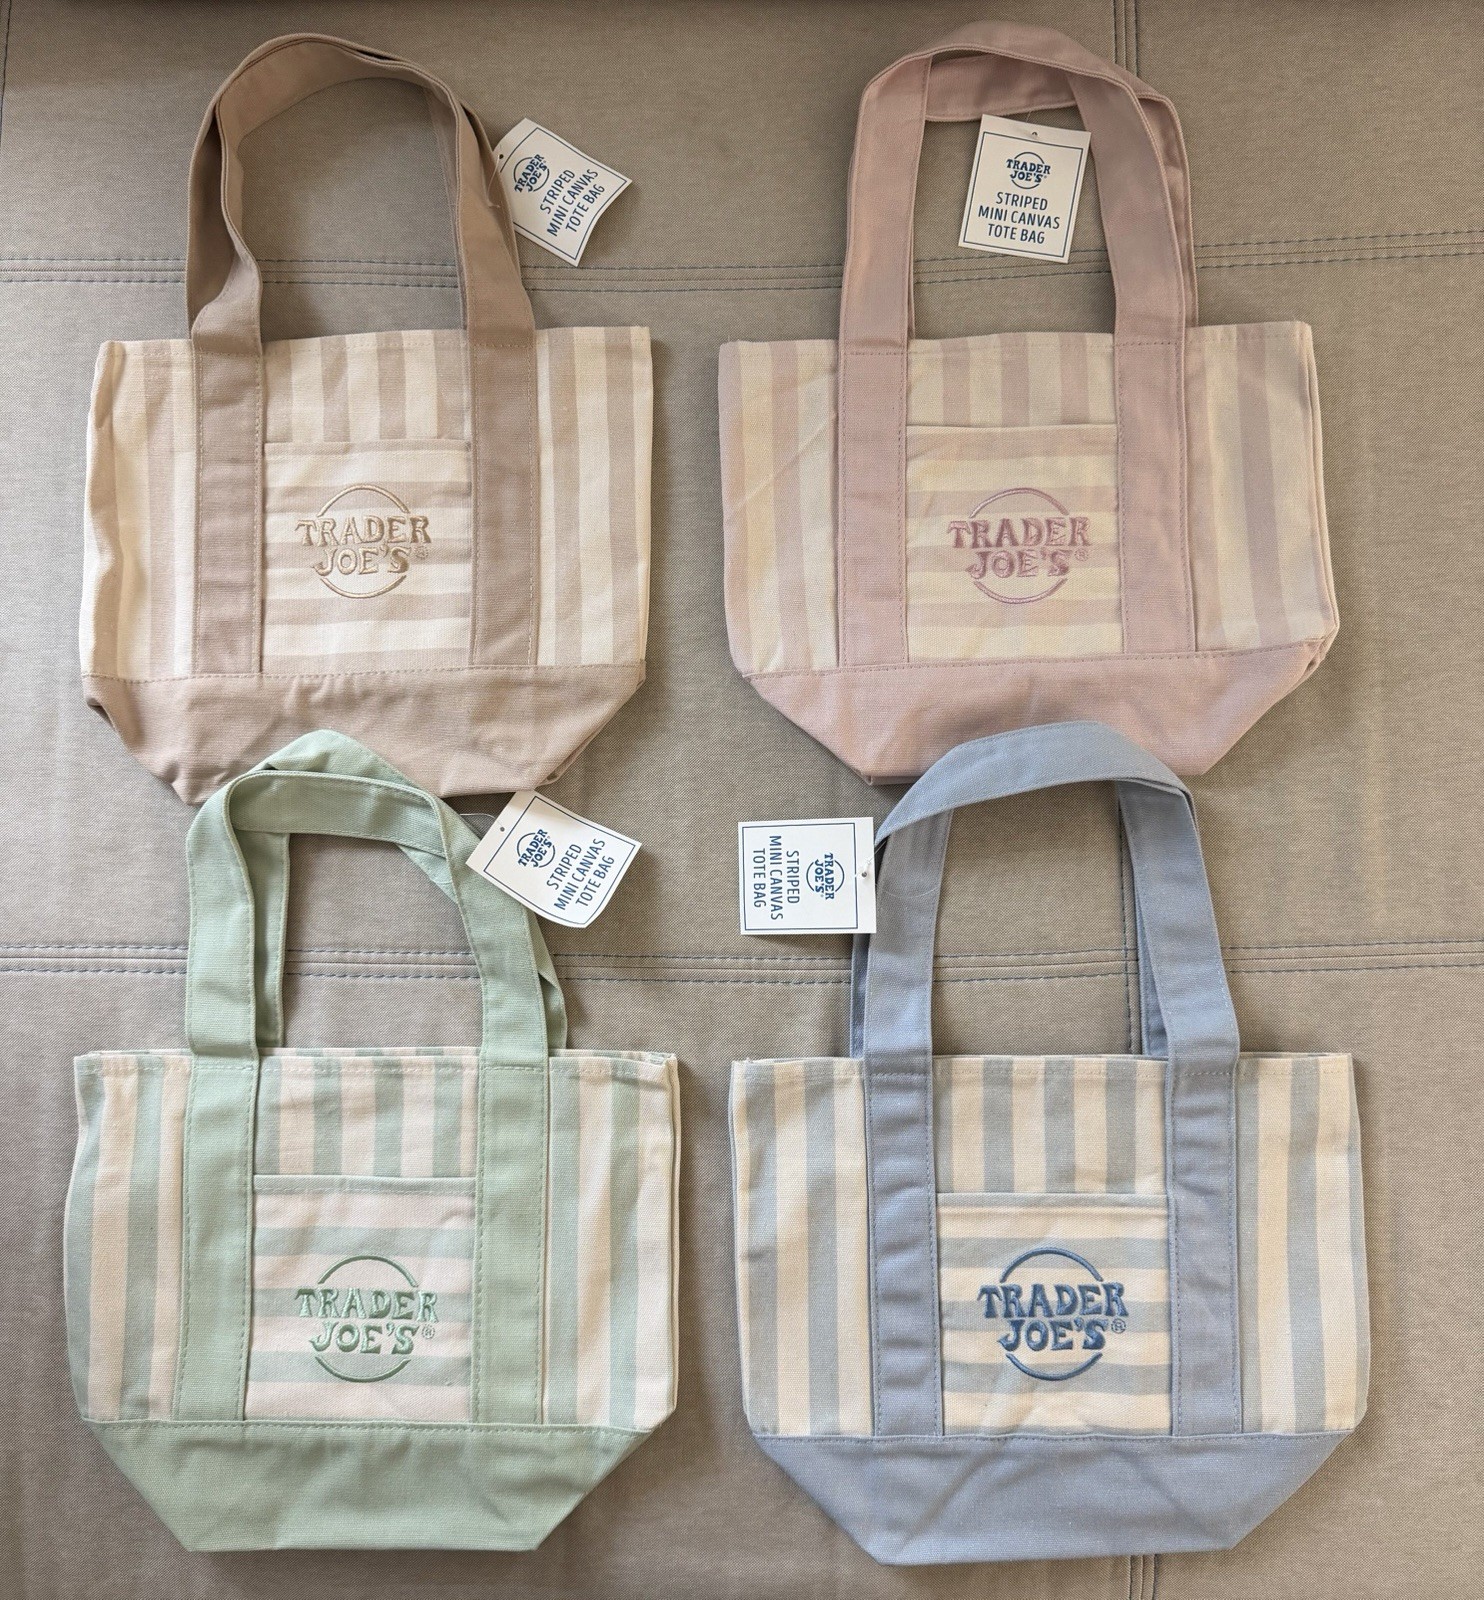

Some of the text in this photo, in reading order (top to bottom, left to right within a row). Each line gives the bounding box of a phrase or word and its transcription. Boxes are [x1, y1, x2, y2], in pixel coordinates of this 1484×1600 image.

[514, 154, 545, 193] TRADER
[1006, 158, 1051, 175] TRADER
[539, 169, 576, 215] STRIPED
[546, 169, 599, 237] MINI CANVAS
[565, 184, 605, 233] TOTE BAG
[995, 191, 1048, 211] STRIPED
[978, 205, 1060, 230] MINI CANVAS
[988, 223, 1045, 244] TOTE BAG
[294, 515, 432, 547] TRADER
[947, 517, 1092, 549] TRADER
[517, 829, 548, 867] TRADER
[546, 843, 582, 891] STRIPED
[553, 838, 606, 911] MINI CANVAS
[575, 855, 615, 907] TOTE BAG
[752, 848, 767, 908] TOTE BAG
[769, 835, 784, 920] MINI CANVAS
[786, 850, 800, 904] STRIPED
[824, 852, 835, 900] TRADER
[294, 1288, 439, 1323] TRADER
[976, 1282, 1129, 1319] TRADER
